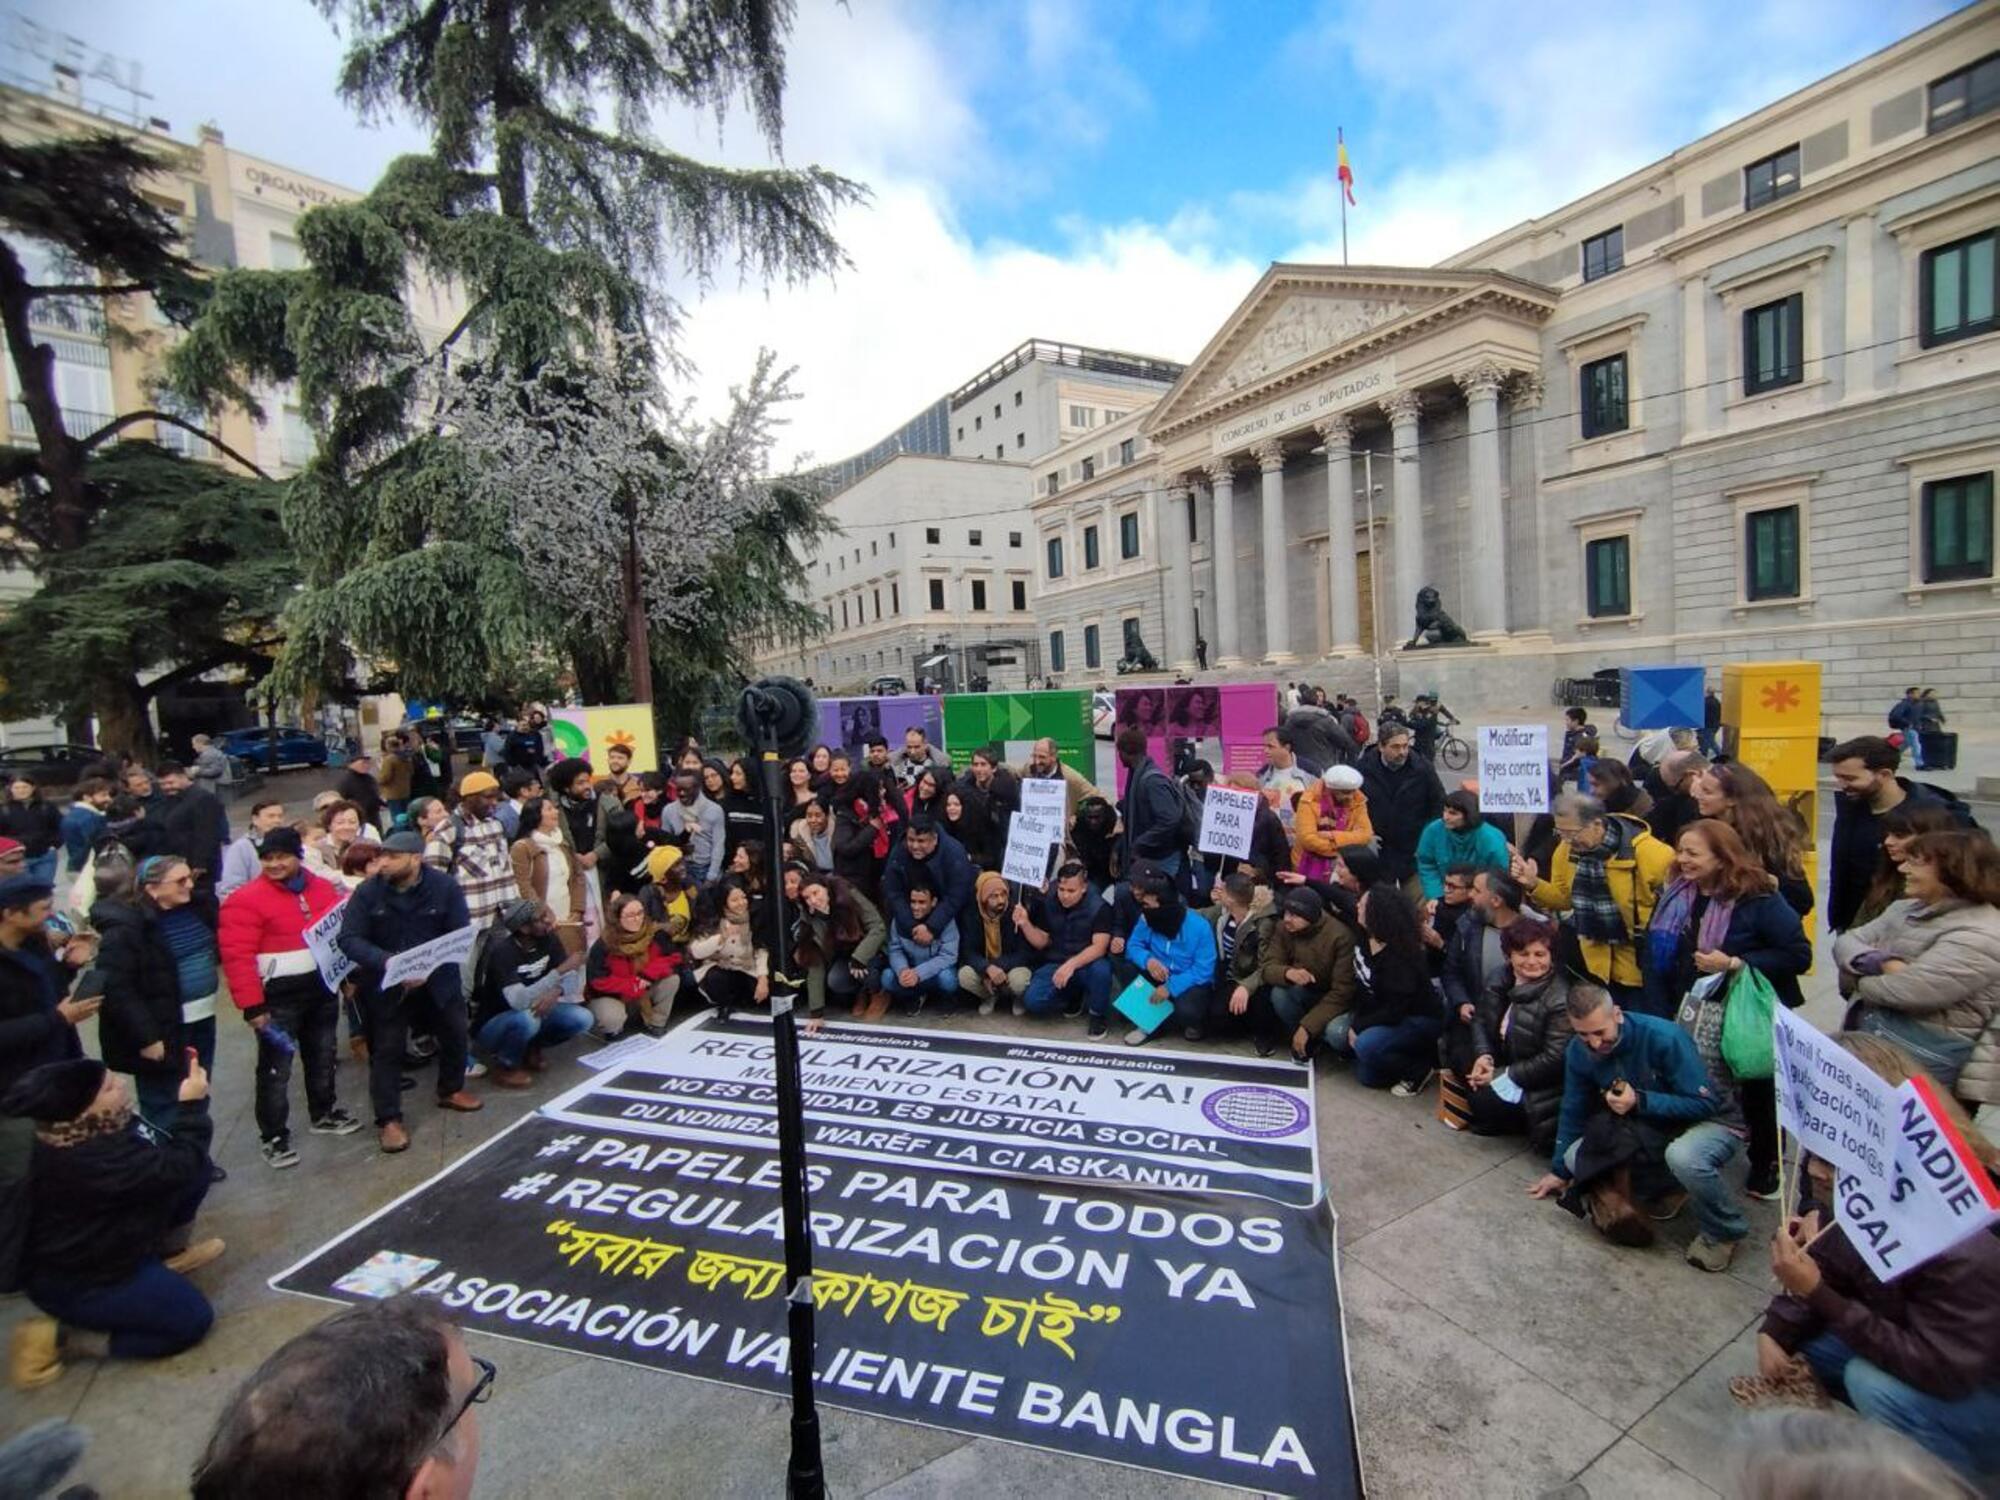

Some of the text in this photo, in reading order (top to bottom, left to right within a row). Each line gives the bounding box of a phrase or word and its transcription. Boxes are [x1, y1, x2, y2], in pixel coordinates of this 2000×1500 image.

[1220, 373, 1381, 443] CONGRESO DE LOS DIPUTADOS
[1488, 728, 1534, 747] Modificar
[1484, 758, 1542, 781] leyes contra
[1207, 830, 1244, 851] TODOS!
[1213, 810, 1240, 830] PARA
[938, 1086, 1087, 1116] ESTATAL
[1114, 1077, 1194, 1105] YA!
[659, 1077, 1230, 1158] NO ES CIDAD, ES JUSTICIA SOCIAL
[1801, 1110, 1838, 1144] para
[621, 1101, 666, 1120] DU
[814, 1125, 932, 1152] WARÉF
[933, 1142, 987, 1162] LA
[987, 1148, 1023, 1169] CI
[1028, 1153, 1210, 1189] ASKANWI
[1901, 1097, 1981, 1217] NADIE
[534, 1134, 1286, 1256] # PAPELES PARA TODOS
[1889, 1159, 1916, 1203] S
[500, 1171, 1257, 1310] # REGULARIZACIÓN YA
[411, 1271, 1317, 1477] ASOCIACIÓN VAIENTE BANGLA
